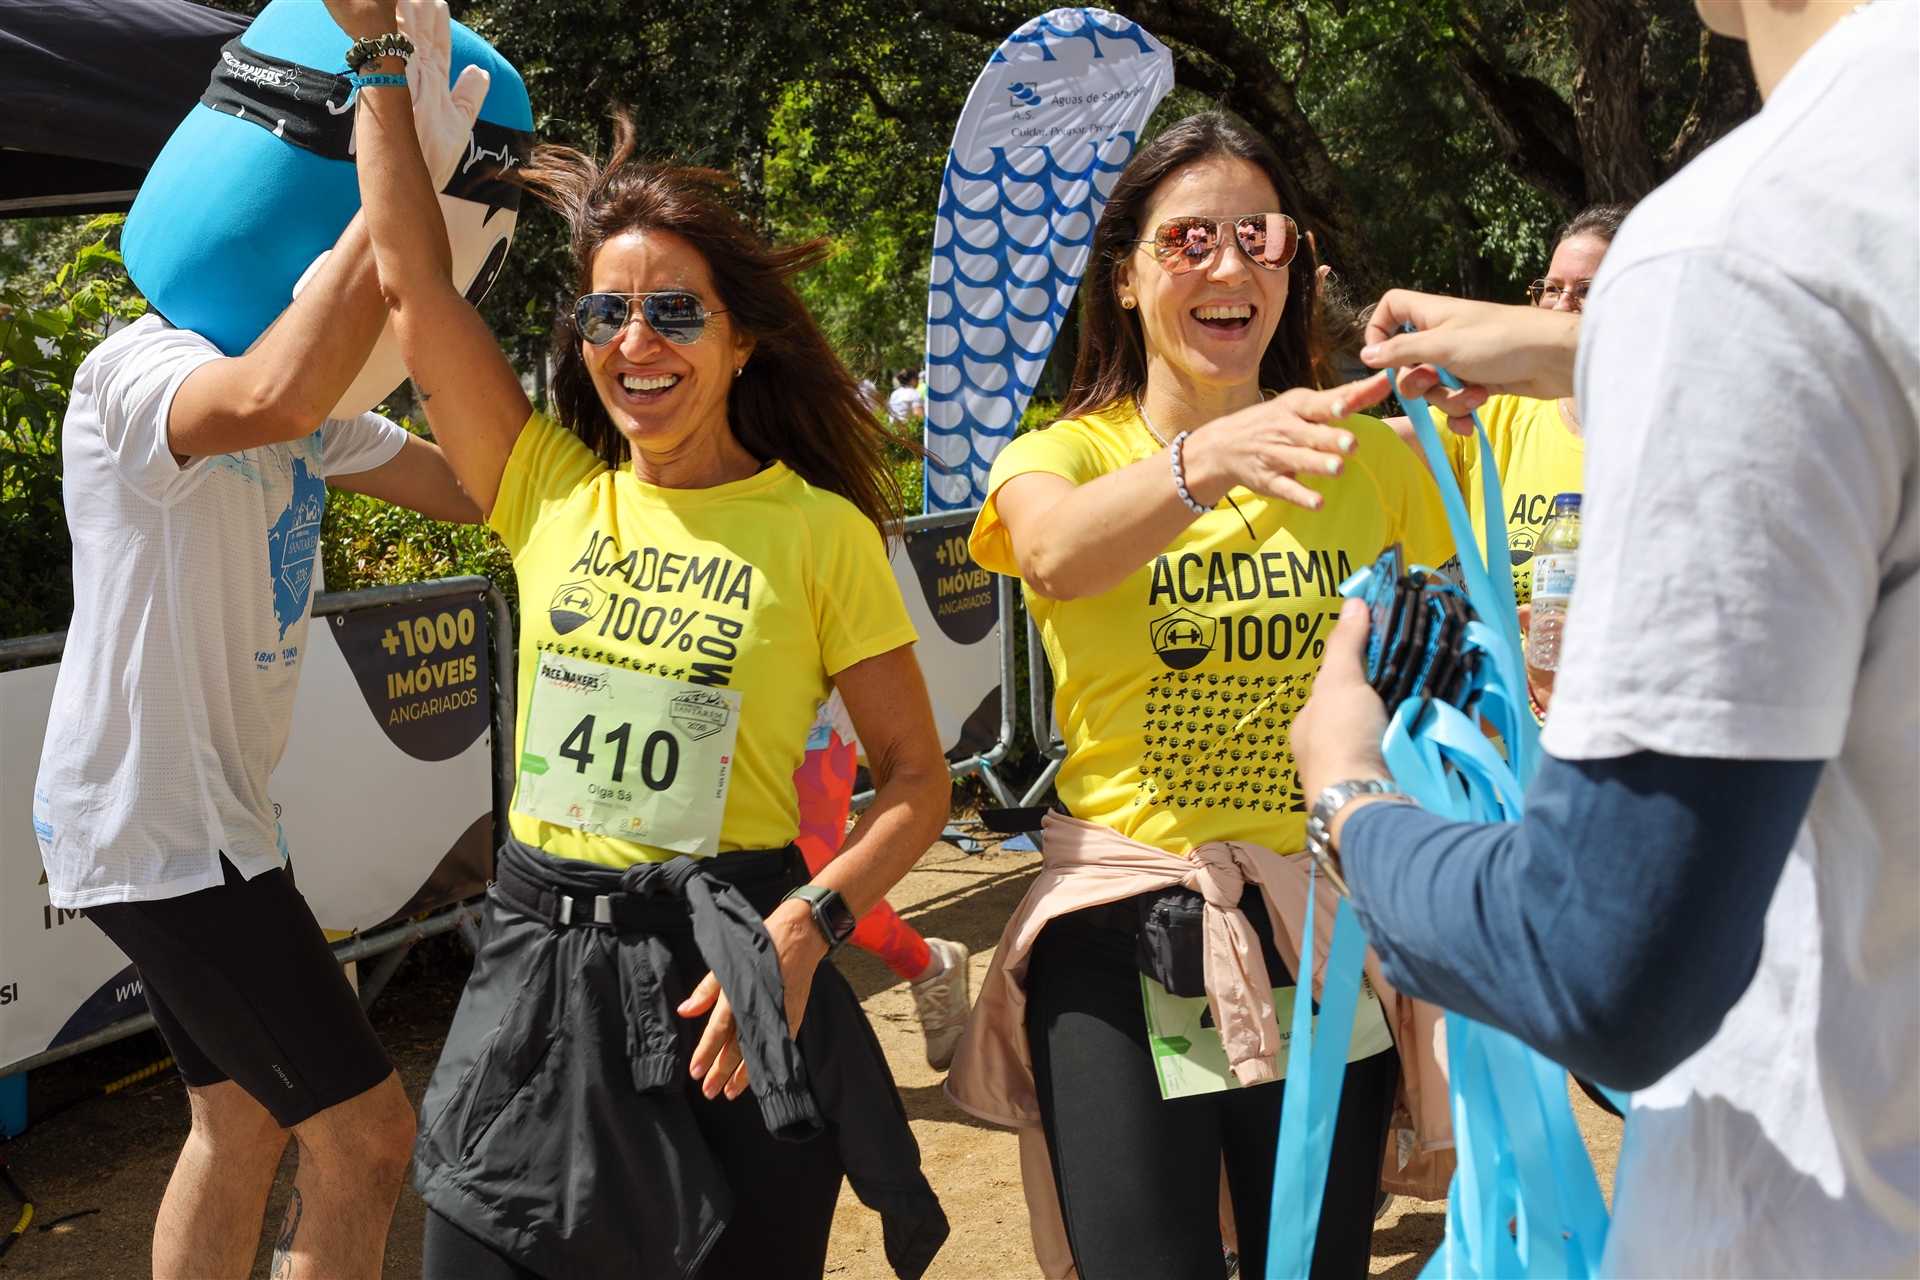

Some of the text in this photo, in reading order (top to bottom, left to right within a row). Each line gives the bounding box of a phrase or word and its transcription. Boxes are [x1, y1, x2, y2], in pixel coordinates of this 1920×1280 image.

[1012, 110, 1035, 120] A.S.
[1051, 92, 1083, 107] Águas
[1086, 93, 1099, 103] de
[569, 530, 752, 610] ACADEMIA
[937, 569, 991, 597] IMÓVEIS
[598, 593, 701, 652] 100%
[938, 591, 992, 617] ANGARIADOS
[381, 608, 475, 656] +1000
[1219, 612, 1325, 663] 100%
[387, 655, 477, 699] IMÓVEIS
[389, 688, 478, 726] ANGARIADOS
[559, 714, 679, 791] 410
[588, 783, 632, 801] Olga Sá
[272, 1064, 294, 1089] EVADICT
